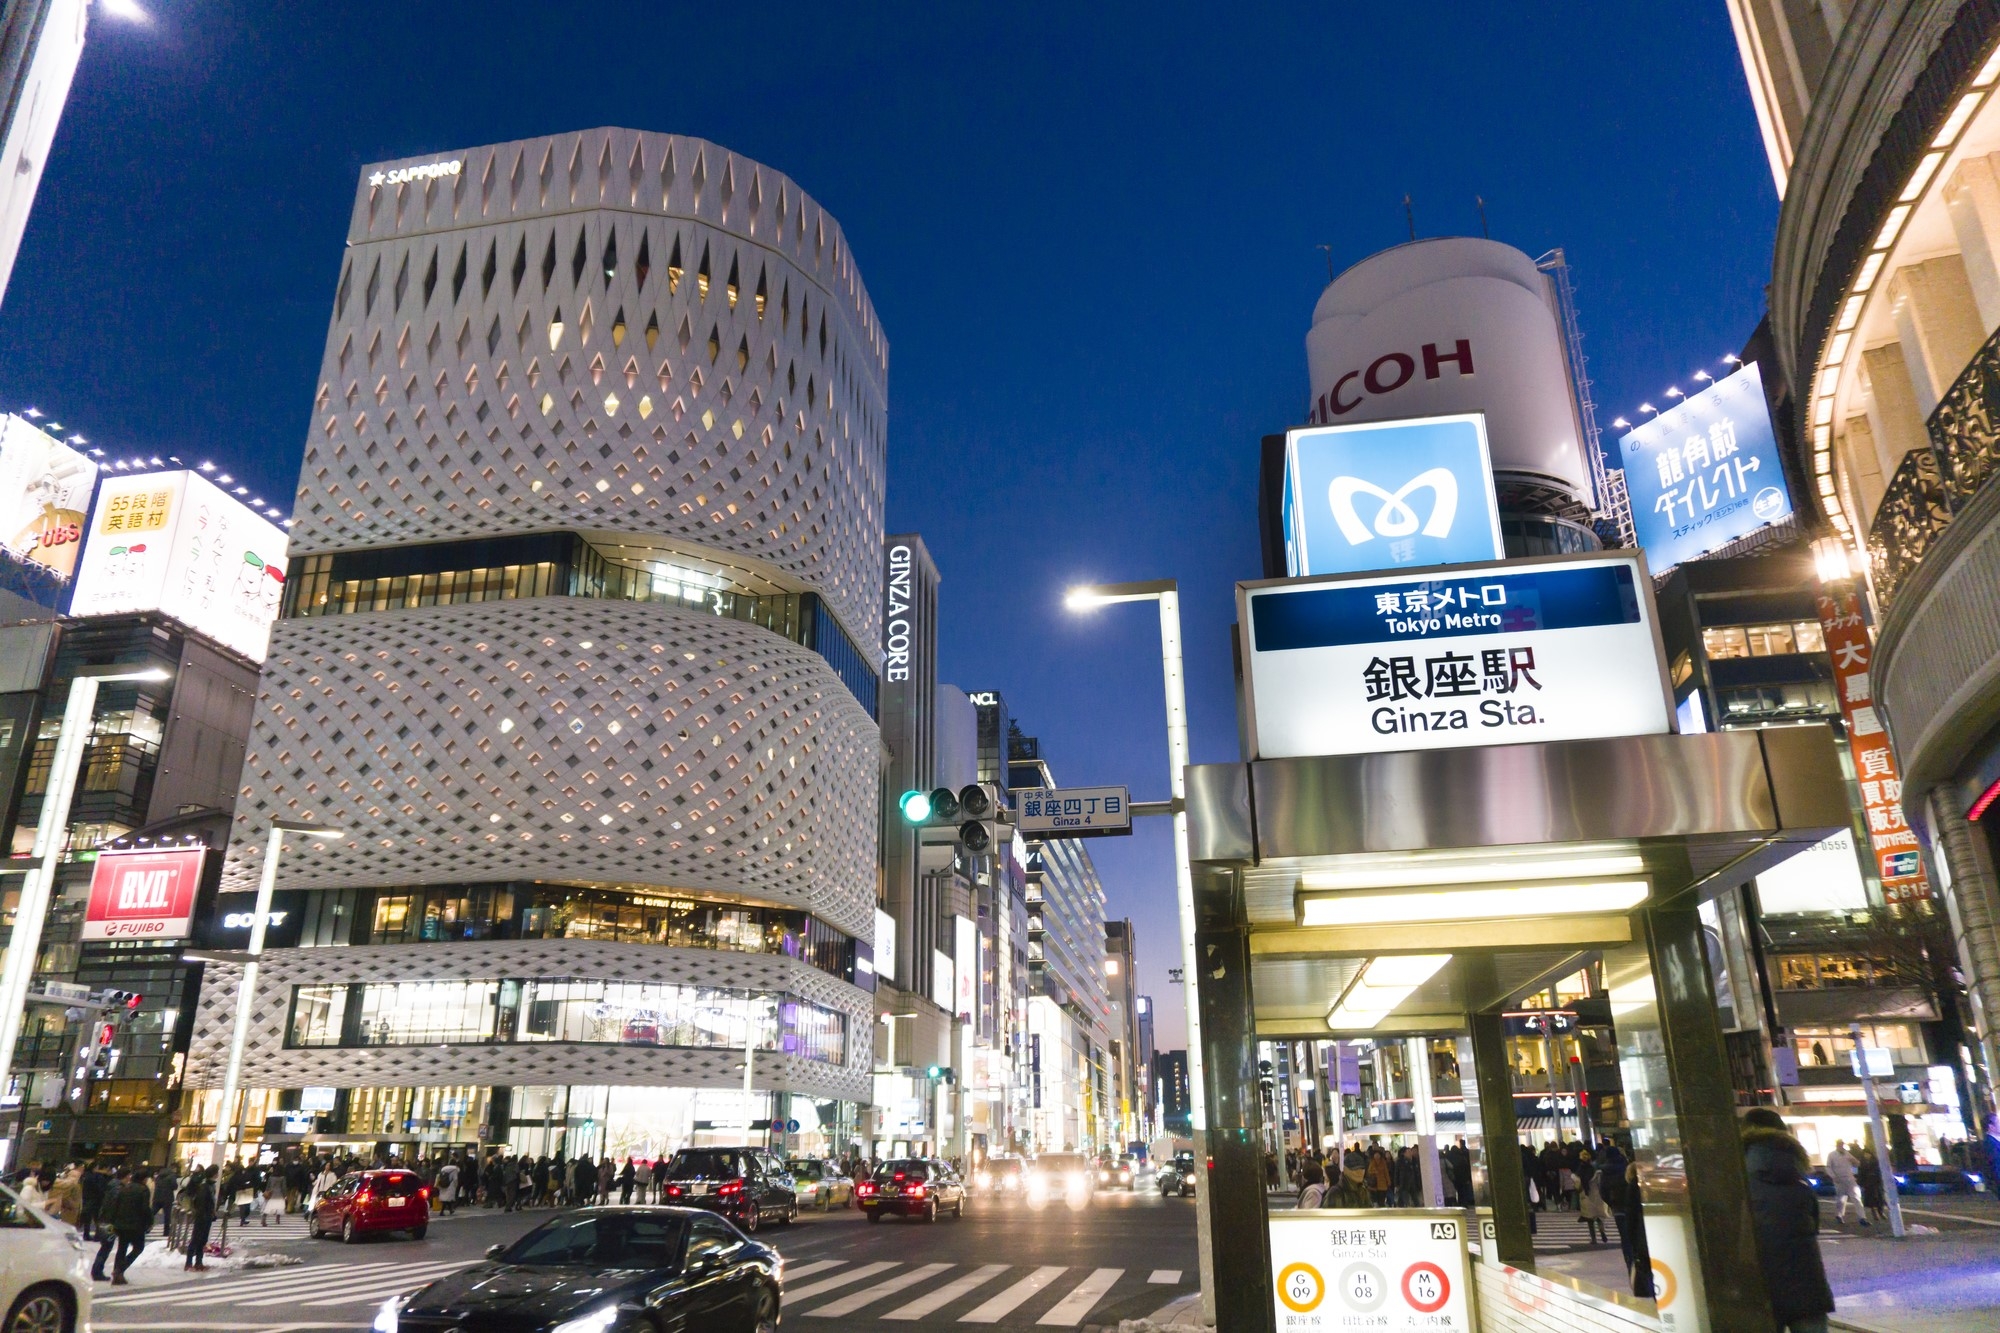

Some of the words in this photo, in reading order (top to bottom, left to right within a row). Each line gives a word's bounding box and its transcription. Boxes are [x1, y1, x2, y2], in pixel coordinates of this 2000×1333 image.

[386, 160, 461, 185] SAPPORO
[1655, 417, 1740, 489] 龍角散
[110, 492, 168, 511] 55段階
[1654, 456, 1760, 527] ダイレクト
[107, 510, 164, 531] 英語村
[41, 522, 79, 549] UBS
[889, 545, 910, 617] GINZA
[1375, 584, 1507, 616] 東京メトロ
[1385, 617, 1441, 635] Tokyo
[1445, 612, 1502, 630] Metro
[887, 619, 910, 682] CORE
[1362, 646, 1543, 703] 銀座駅
[970, 692, 997, 706] NCL
[1371, 702, 1469, 735] Ginza
[1480, 700, 1546, 728] Sta.
[1860, 747, 1894, 778] 質
[1023, 789, 1053, 800] 中央区
[1861, 778, 1902, 806] 買取
[1024, 796, 1120, 818] 銀座四丁目
[1053, 815, 1080, 826] Ginza
[1084, 816, 1091, 826] 4
[1867, 803, 1909, 832] 販売
[119, 922, 164, 936] FUJIBO
[224, 911, 288, 928] SOY
[1330, 1229, 1387, 1246] 銀座駅
[1433, 1224, 1454, 1239] A9
[1332, 1249, 1364, 1258] Ginza
[1295, 1274, 1306, 1284] G
[1357, 1274, 1367, 1284] H
[1418, 1274, 1431, 1283] M
[1292, 1287, 1311, 1298] 09
[1354, 1287, 1373, 1298] 08
[1418, 1287, 1435, 1298] 16
